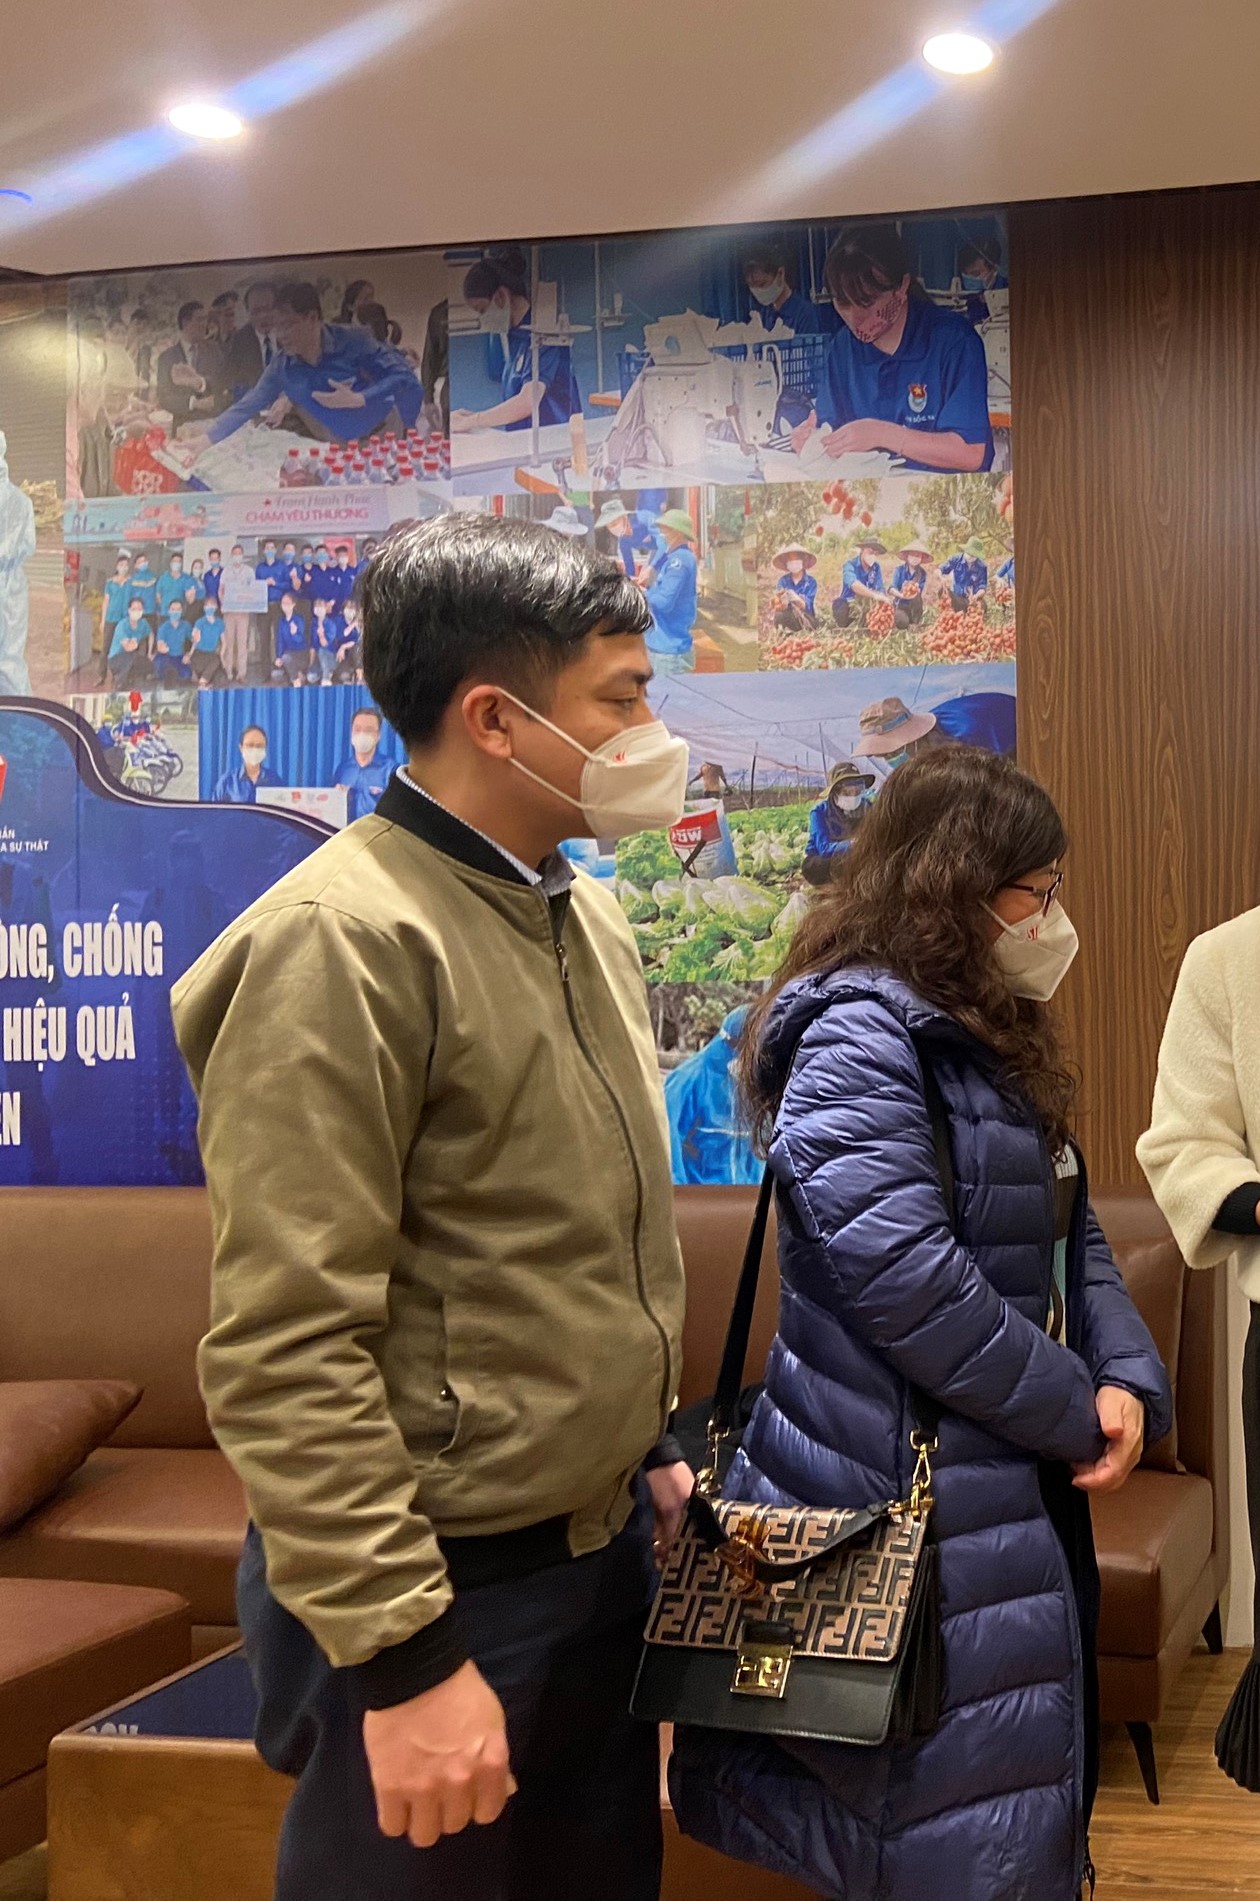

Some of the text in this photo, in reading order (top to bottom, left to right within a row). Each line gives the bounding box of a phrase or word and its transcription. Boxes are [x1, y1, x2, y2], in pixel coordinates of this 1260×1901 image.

[62, 902, 163, 978] CHỐNG
[3, 992, 136, 1072] HIỆU QUẢ
[0, 1091, 21, 1146] N
